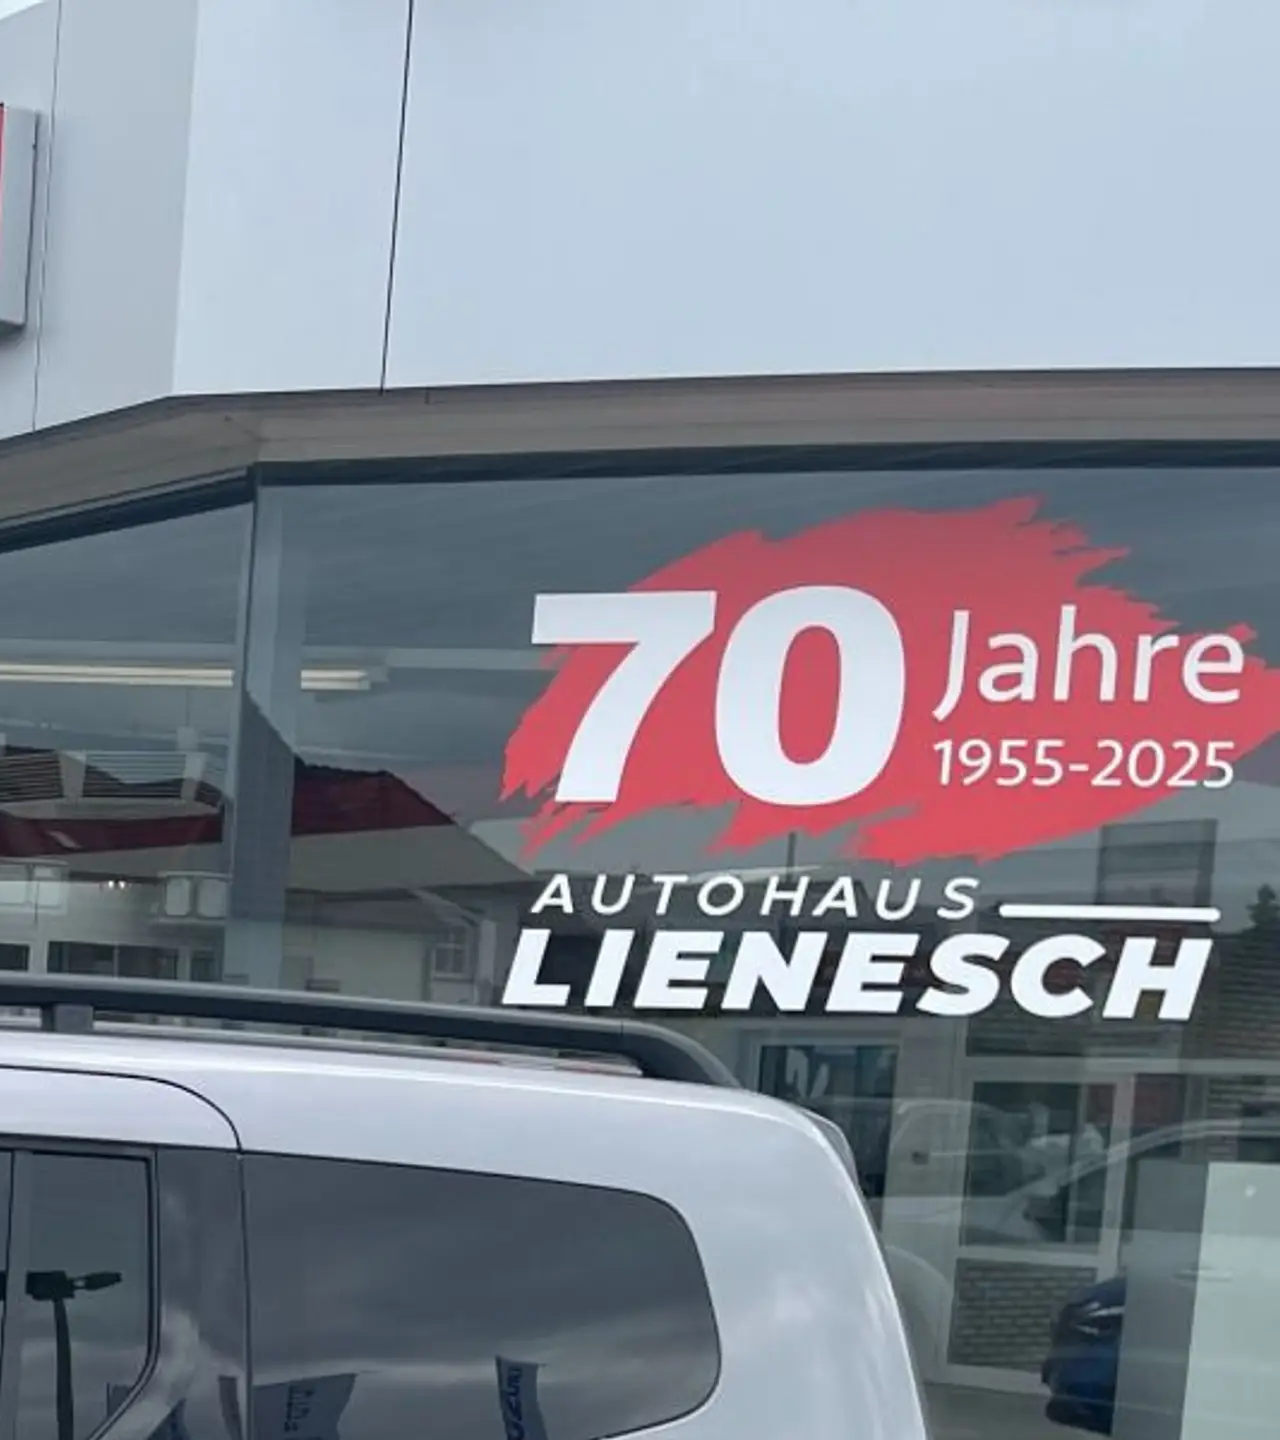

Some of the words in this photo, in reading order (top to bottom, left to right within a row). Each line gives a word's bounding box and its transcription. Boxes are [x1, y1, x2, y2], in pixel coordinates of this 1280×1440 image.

[531, 585, 906, 806] 70
[932, 604, 1244, 720] Jahre
[933, 738, 1236, 789] 1955-2025
[530, 872, 981, 920] AUTOHAUS
[501, 928, 1214, 1022] LIENESCH
